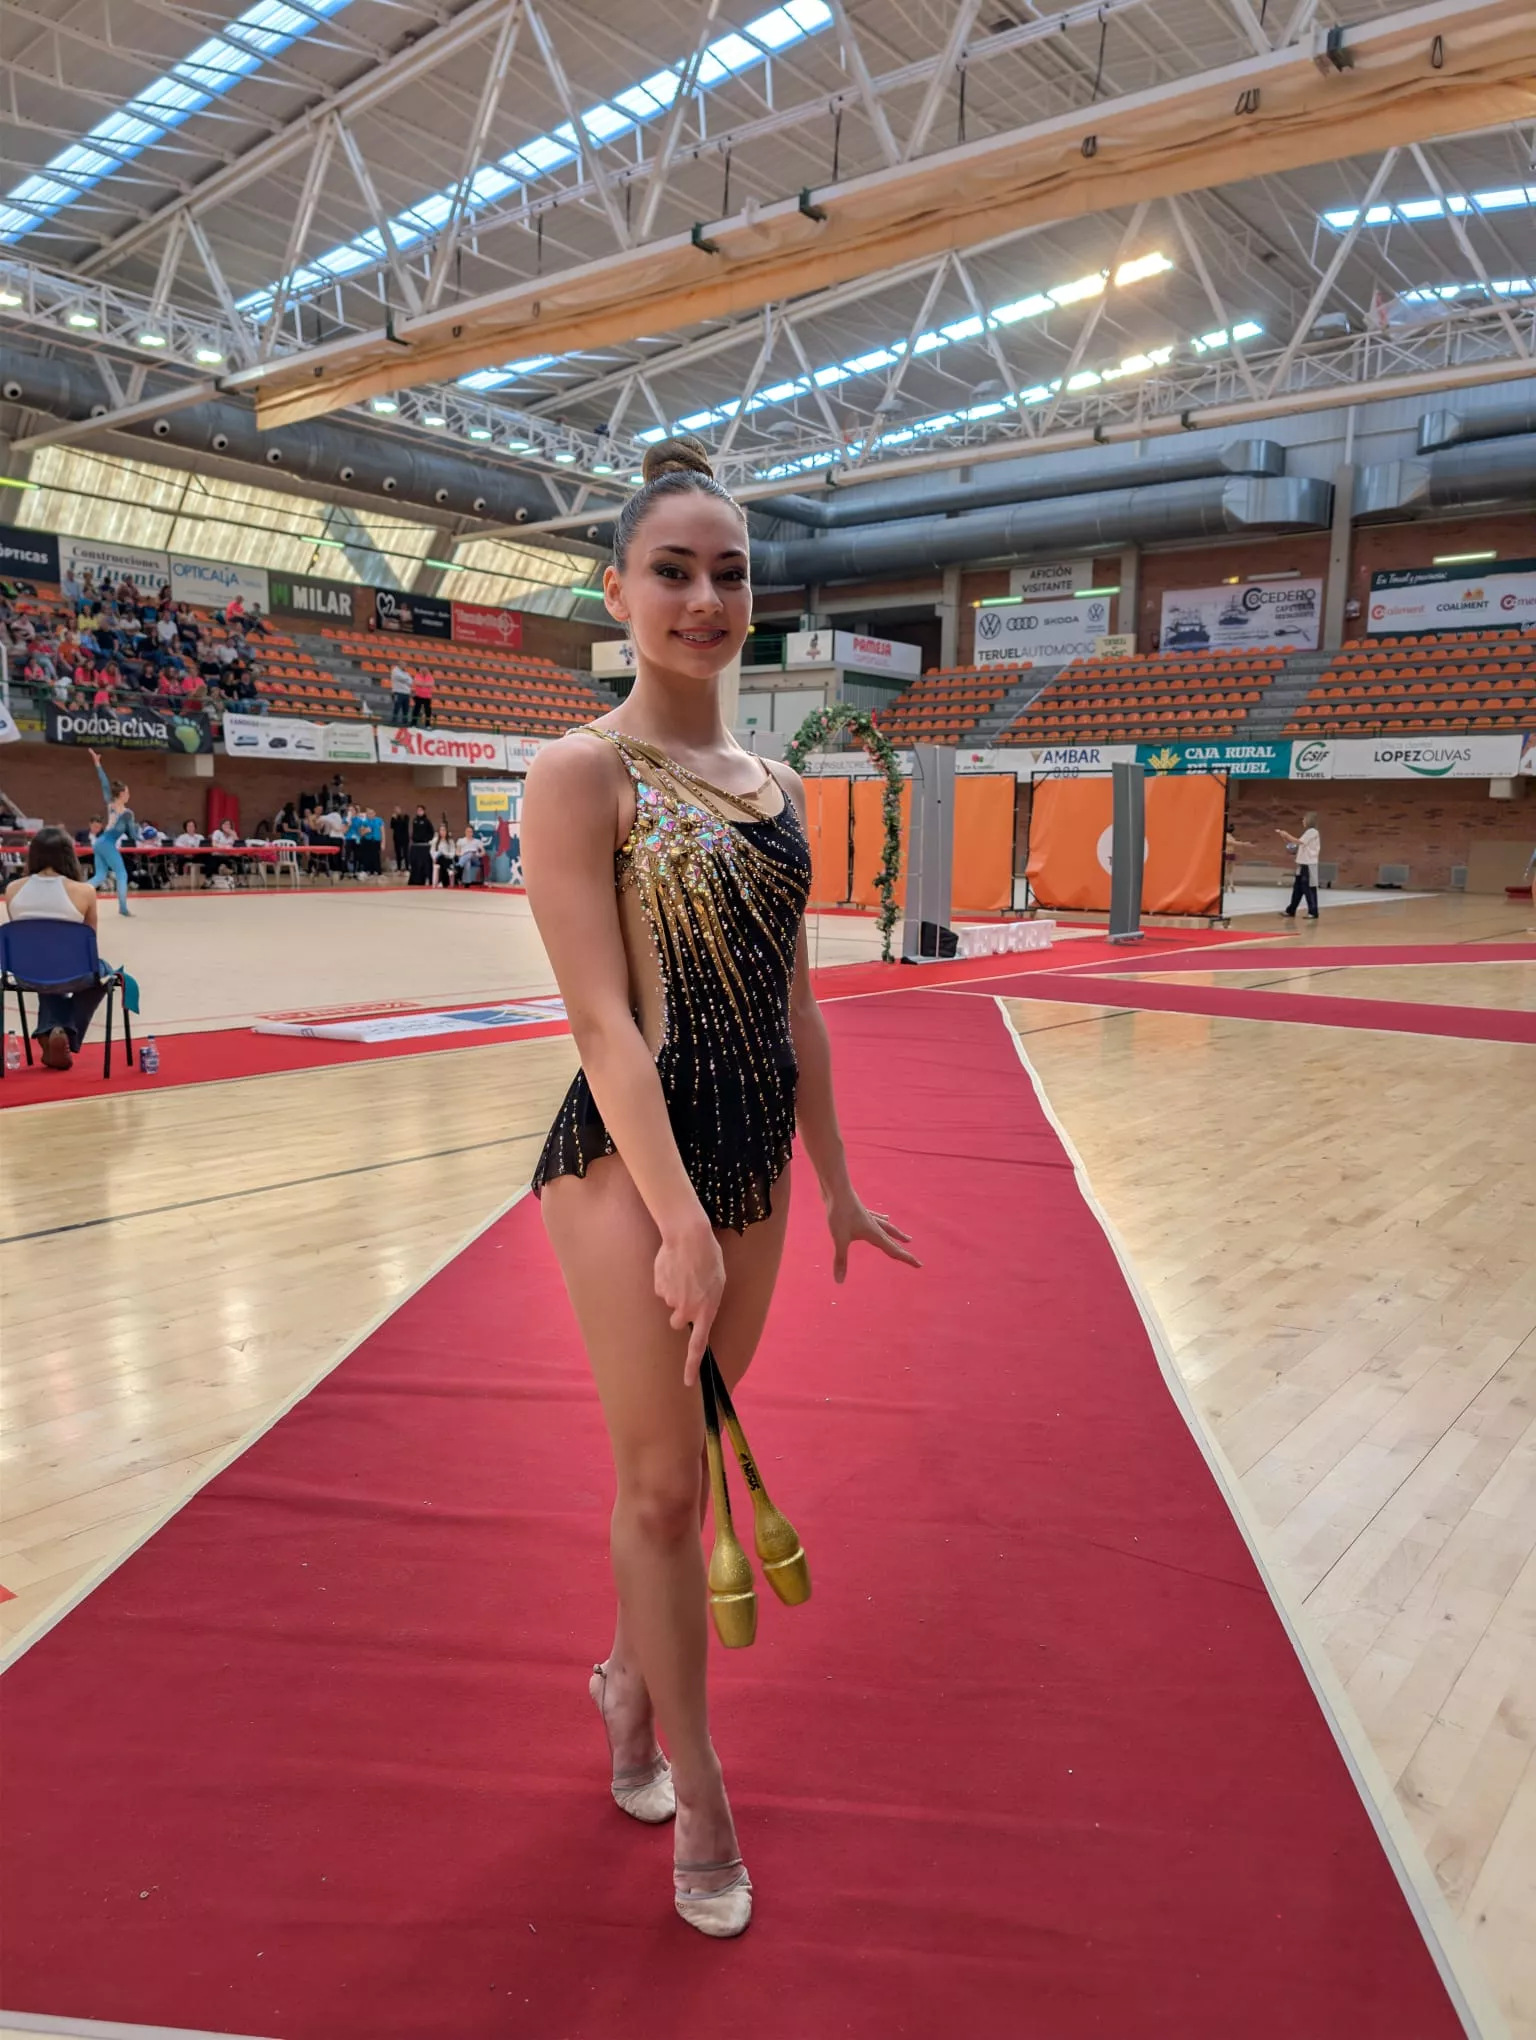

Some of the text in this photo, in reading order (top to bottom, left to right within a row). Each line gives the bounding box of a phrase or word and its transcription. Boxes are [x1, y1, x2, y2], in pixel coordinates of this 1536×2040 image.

[72, 546, 160, 569] Construcciones
[1030, 567, 1073, 580] AFICIÓN
[1022, 580, 1073, 593] VISITANTE
[292, 585, 352, 616] MILAR
[1436, 601, 1489, 612] COALIMENT
[57, 714, 169, 741] podoactiva
[390, 727, 496, 764] Alcampo
[1043, 749, 1100, 764] AMBAR
[1185, 746, 1276, 759] CAJA RURAL
[1302, 750, 1329, 762] CSIF
[1186, 763, 1207, 774] DE
